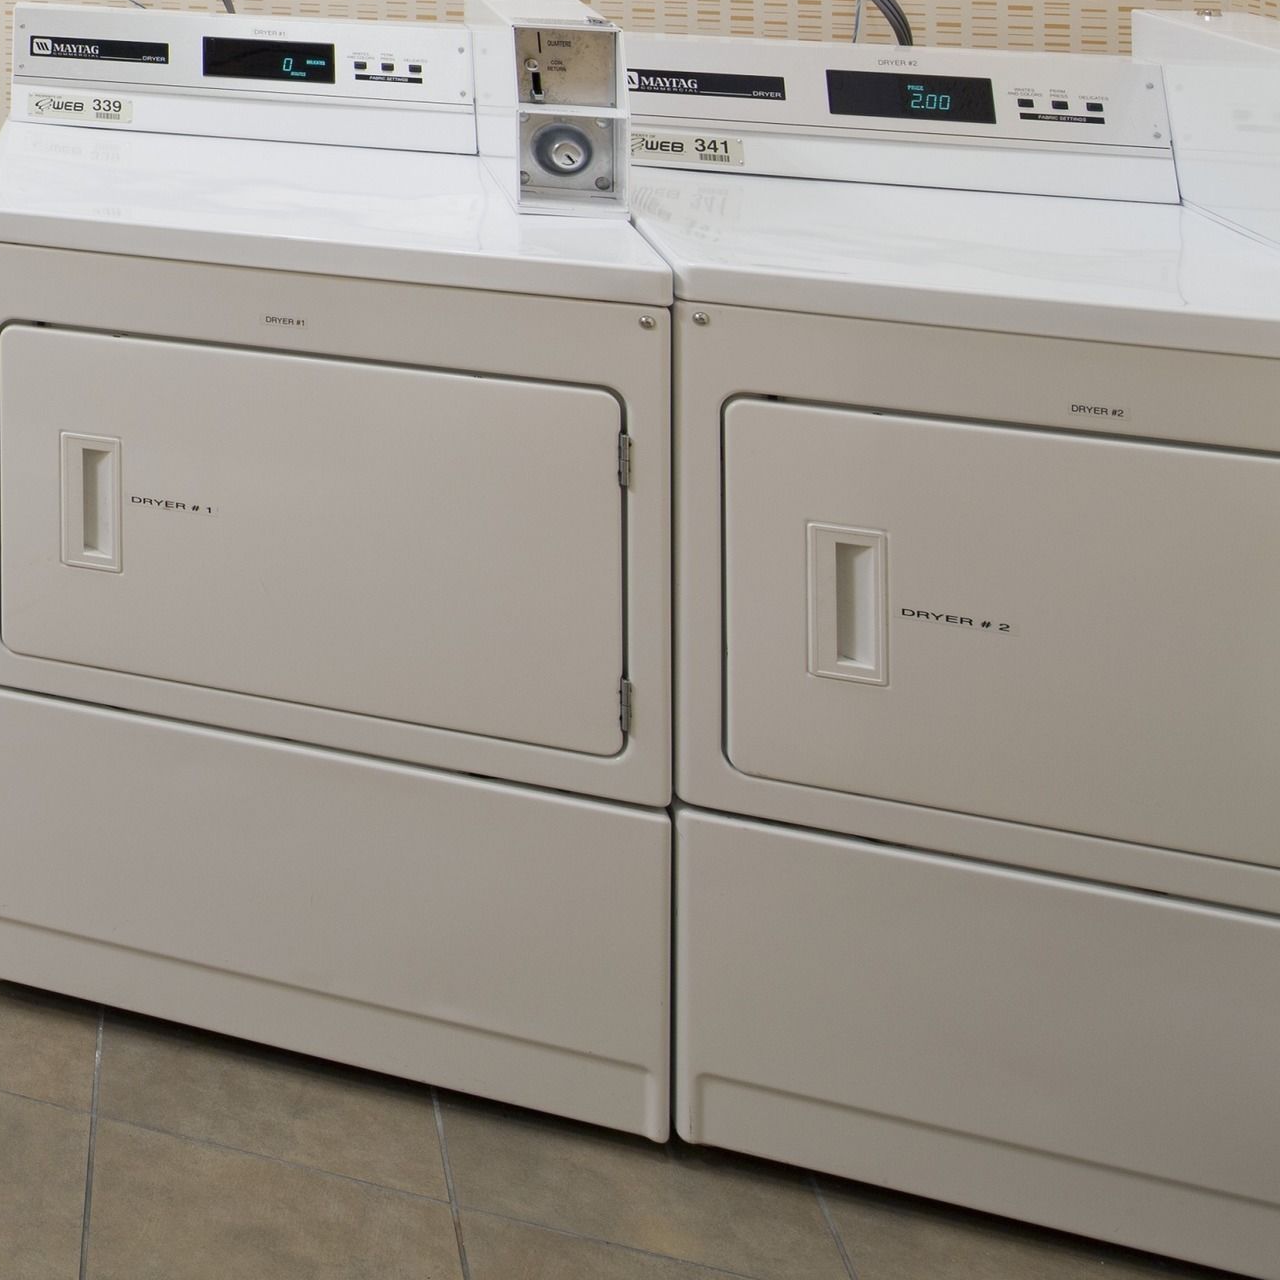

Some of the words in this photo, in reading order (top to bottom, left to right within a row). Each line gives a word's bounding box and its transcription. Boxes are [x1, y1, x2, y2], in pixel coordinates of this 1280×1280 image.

[53, 43, 99, 55] MAYTAG
[547, 40, 572, 48] QUARTERS
[282, 58, 293, 71] 0
[640, 76, 698, 89] MAYTAG
[752, 90, 782, 98] DRYER
[53, 101, 84, 112] WEB
[93, 99, 122, 112] 339
[911, 93, 951, 110] 2.00
[645, 140, 684, 153] WEB
[694, 138, 728, 154] 341
[265, 316, 294, 325] DRYER
[1071, 404, 1109, 416] DRYER
[1112, 409, 1124, 418] #2
[131, 496, 186, 510] DRYER
[206, 506, 212, 514] 1
[901, 608, 973, 626] DRYER
[999, 623, 1010, 632] 2
